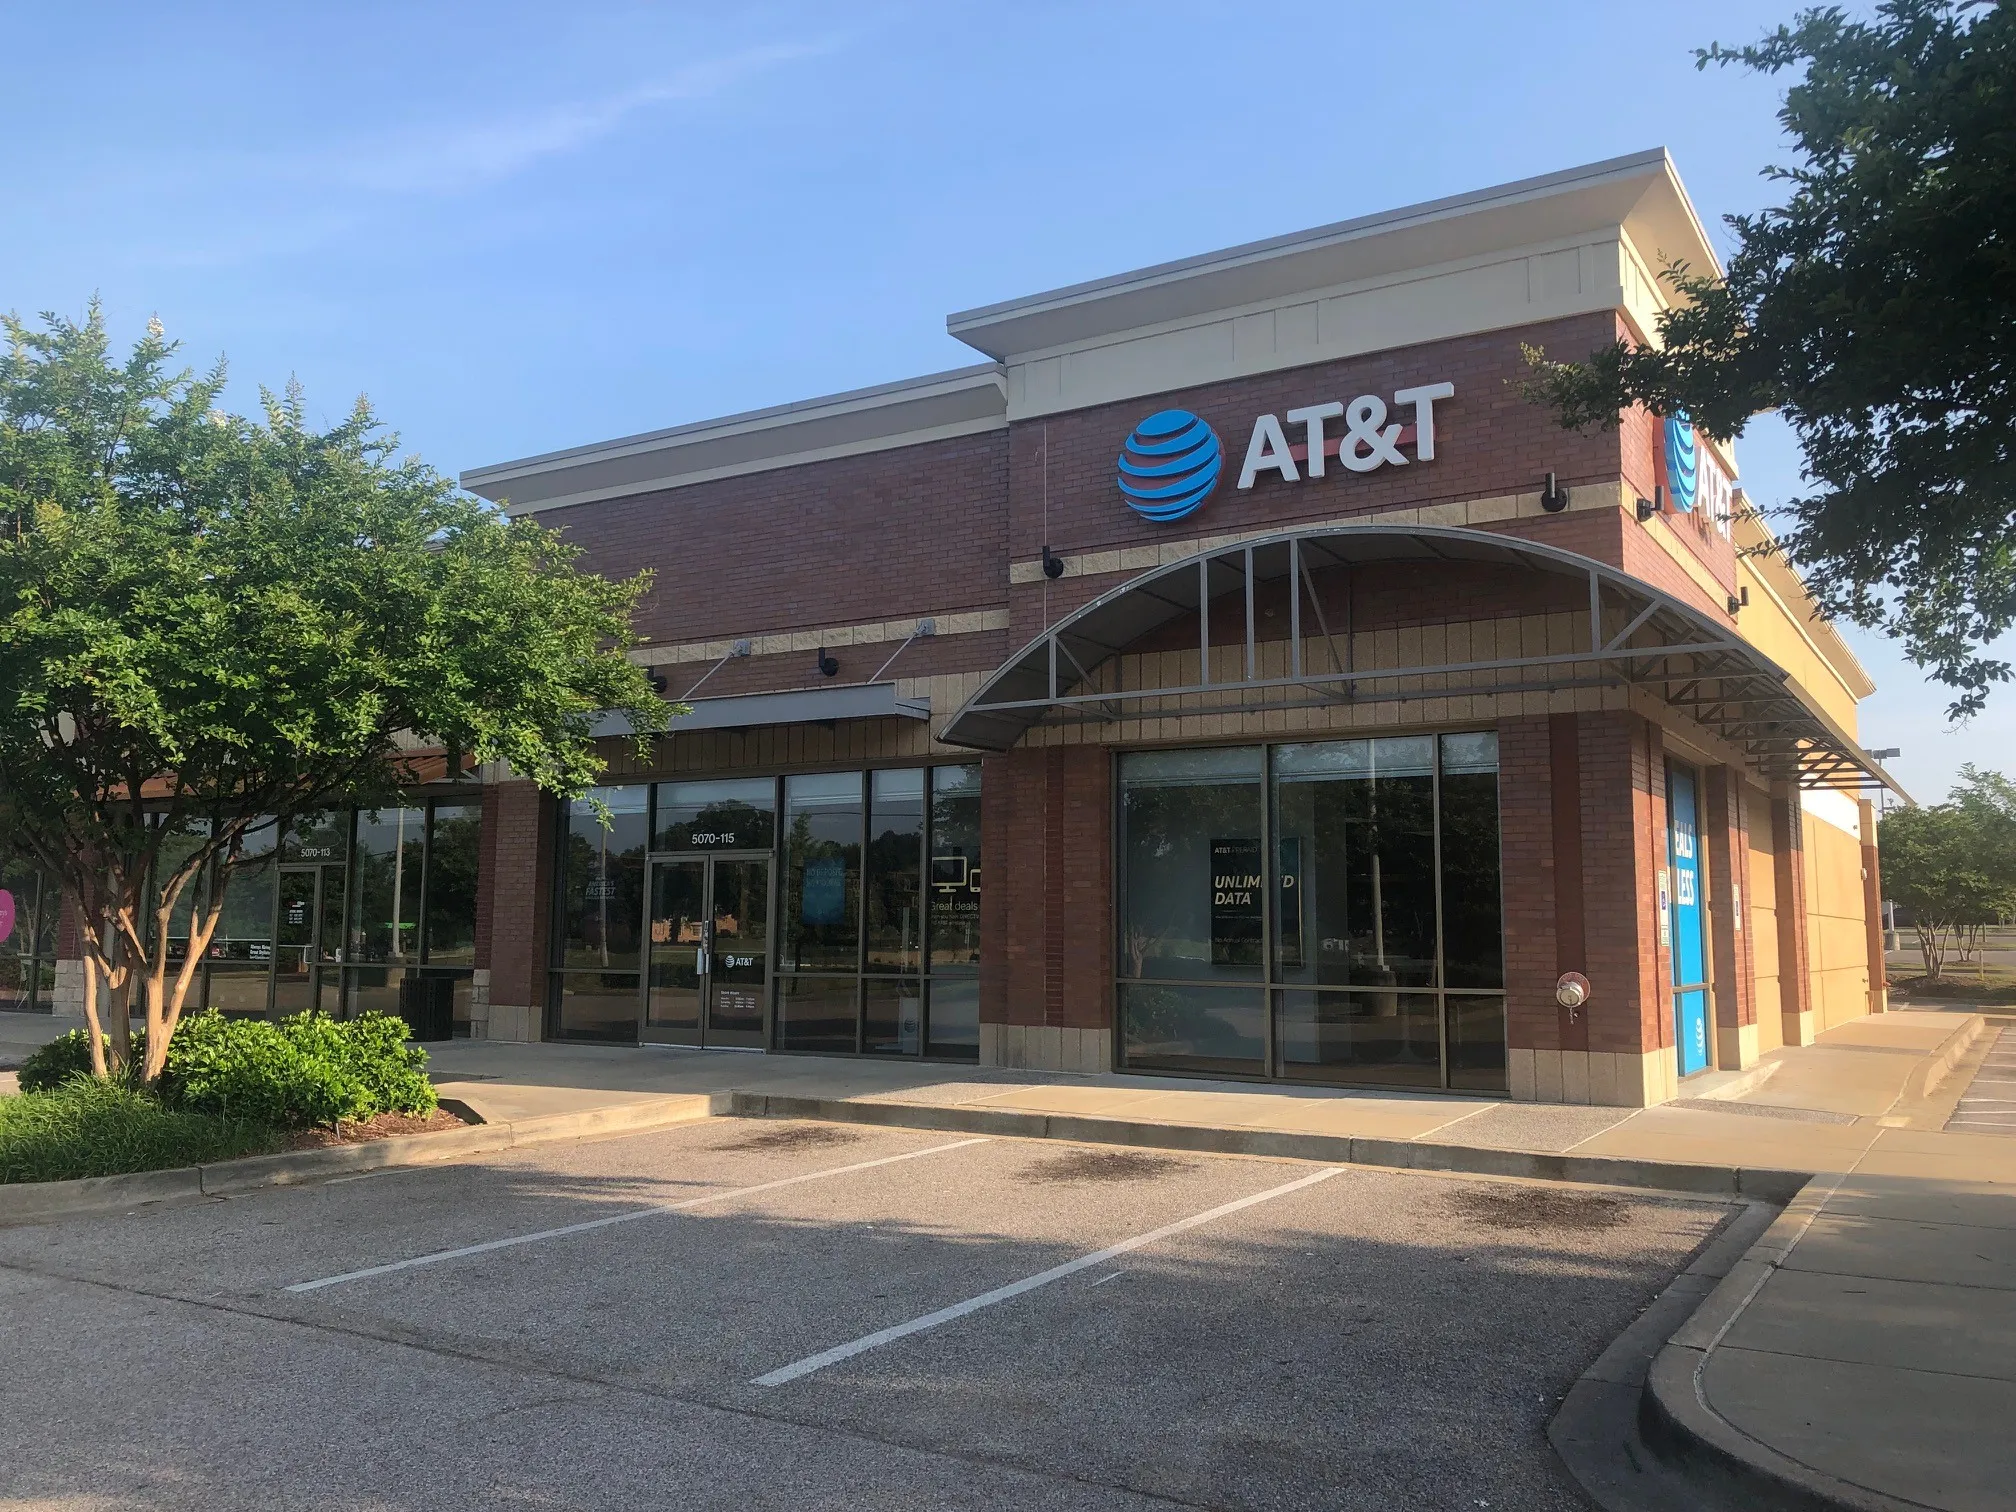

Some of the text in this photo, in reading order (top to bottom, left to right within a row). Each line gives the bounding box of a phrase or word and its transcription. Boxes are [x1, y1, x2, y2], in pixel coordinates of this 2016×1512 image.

[1237, 381, 1455, 489] AT&T
[1697, 444, 1732, 544] AT&T
[691, 832, 735, 845] 5070-115
[1674, 819, 1693, 859] EALS
[300, 847, 331, 858] 5070-113
[1214, 846, 1231, 854] AT&T
[1214, 874, 1295, 889] UNLIMD
[1677, 867, 1695, 906] LESS
[585, 886, 617, 896] FASTEST
[1214, 892, 1251, 905] DATA
[954, 901, 979, 911] deals
[735, 957, 754, 966] AT&T
